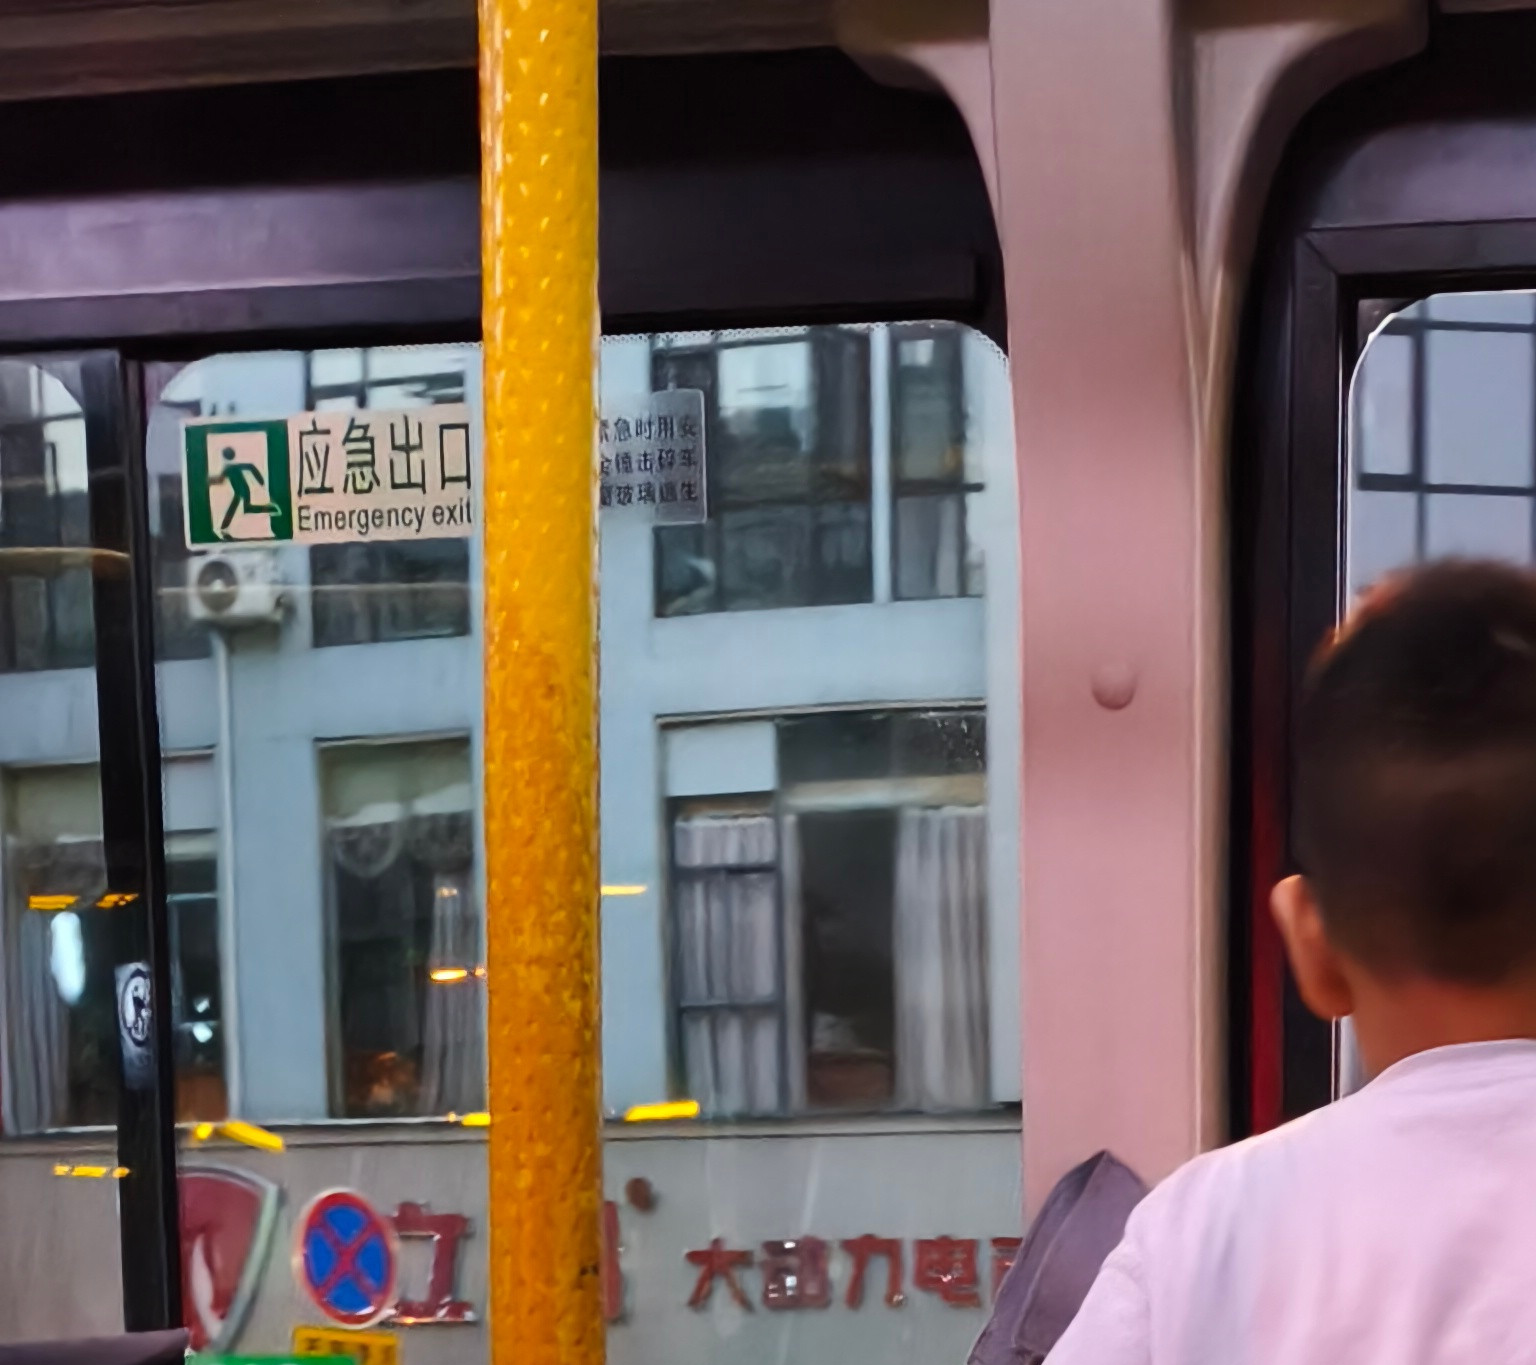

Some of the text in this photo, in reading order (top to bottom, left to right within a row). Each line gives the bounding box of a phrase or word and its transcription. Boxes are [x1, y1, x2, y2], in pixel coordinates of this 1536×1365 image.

[297, 415, 472, 498] 应急出口
[297, 504, 426, 536] Emergency
